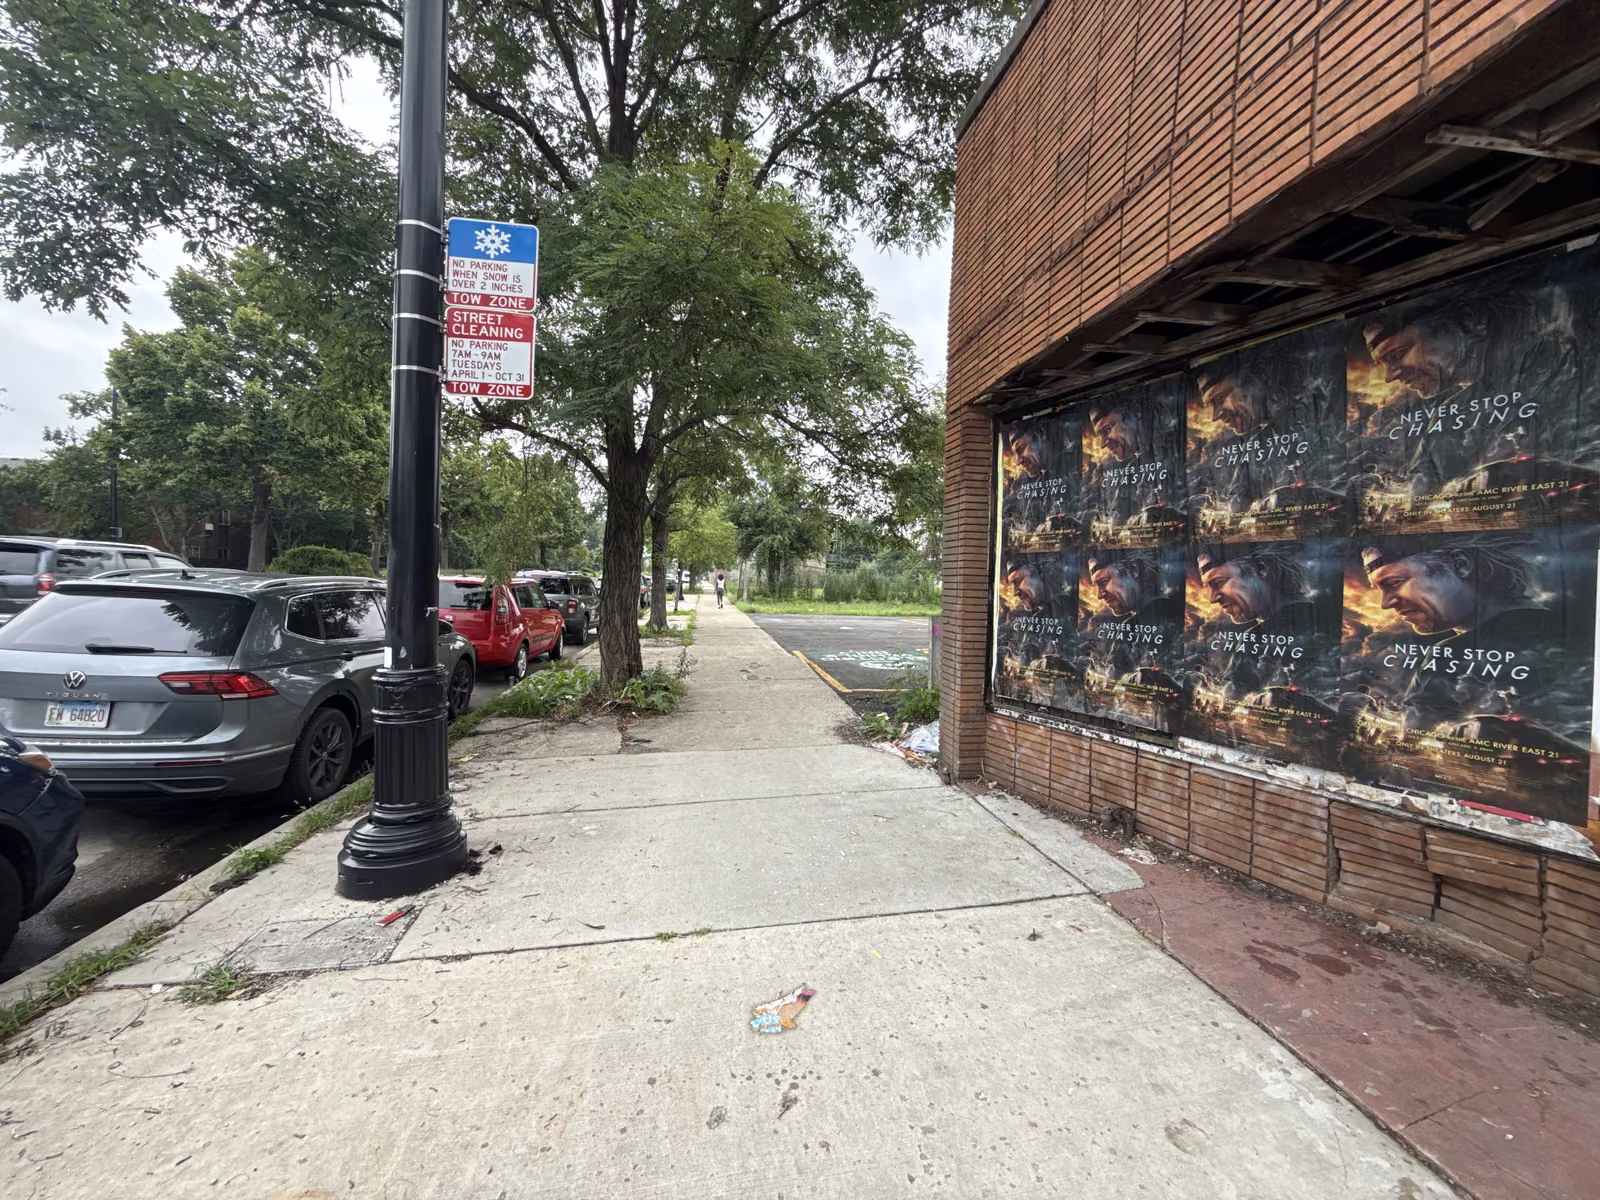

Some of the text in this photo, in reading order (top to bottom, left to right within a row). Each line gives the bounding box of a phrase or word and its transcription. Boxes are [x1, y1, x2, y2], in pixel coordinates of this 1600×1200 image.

[452, 260, 508, 272] NO PARKING
[452, 270, 521, 283] WHEN SNOW IS
[452, 279, 524, 294] OVER 2 INCHES
[452, 292, 526, 309] TOW ZONE
[453, 311, 503, 325] STREET
[452, 324, 524, 339] CLEANING
[452, 340, 508, 351] NO PARKING
[452, 359, 502, 371] TUESDAYS
[452, 370, 479, 380] APRIL
[516, 373, 525, 382] 31
[452, 382, 524, 396] TOW ZONE
[1400, 391, 1522, 425] NEVER STOP
[1388, 402, 1537, 440] CHASING
[1222, 433, 1299, 455] NEVER STOP
[1214, 441, 1309, 468] CHASING
[1106, 462, 1162, 478] NEVER STOP
[1021, 478, 1063, 490] NEVER STOP
[1101, 470, 1168, 488] CHASING
[1017, 485, 1067, 500] CHASING
[1414, 493, 1452, 502] CHICAGO
[1477, 487, 1499, 496] AMC
[1502, 484, 1528, 494] RIVER
[1531, 482, 1555, 491] EAST
[1557, 480, 1569, 488] 21
[1403, 509, 1421, 517] ONLY
[1472, 503, 1505, 512] AUGUST
[1013, 622, 1063, 635] CHASING
[1017, 616, 1059, 626] NEVER STOP
[1103, 622, 1158, 634] NEVER STOP
[1097, 630, 1164, 645] CHASING
[1219, 631, 1295, 645] NEVER STOP
[1210, 640, 1304, 659] CHASING
[1395, 643, 1515, 663] NEVER STOP
[1383, 654, 1530, 680] CHASING
[1279, 707, 1295, 715] RIVER
[1406, 728, 1446, 739] CHICAGO
[1469, 739, 1491, 748] AMC
[1493, 742, 1519, 752] RIVER
[1522, 746, 1545, 756] EAST
[1548, 750, 1559, 759] 21
[1396, 741, 1414, 749] ONLY
[1463, 753, 1495, 764] AUGUST
